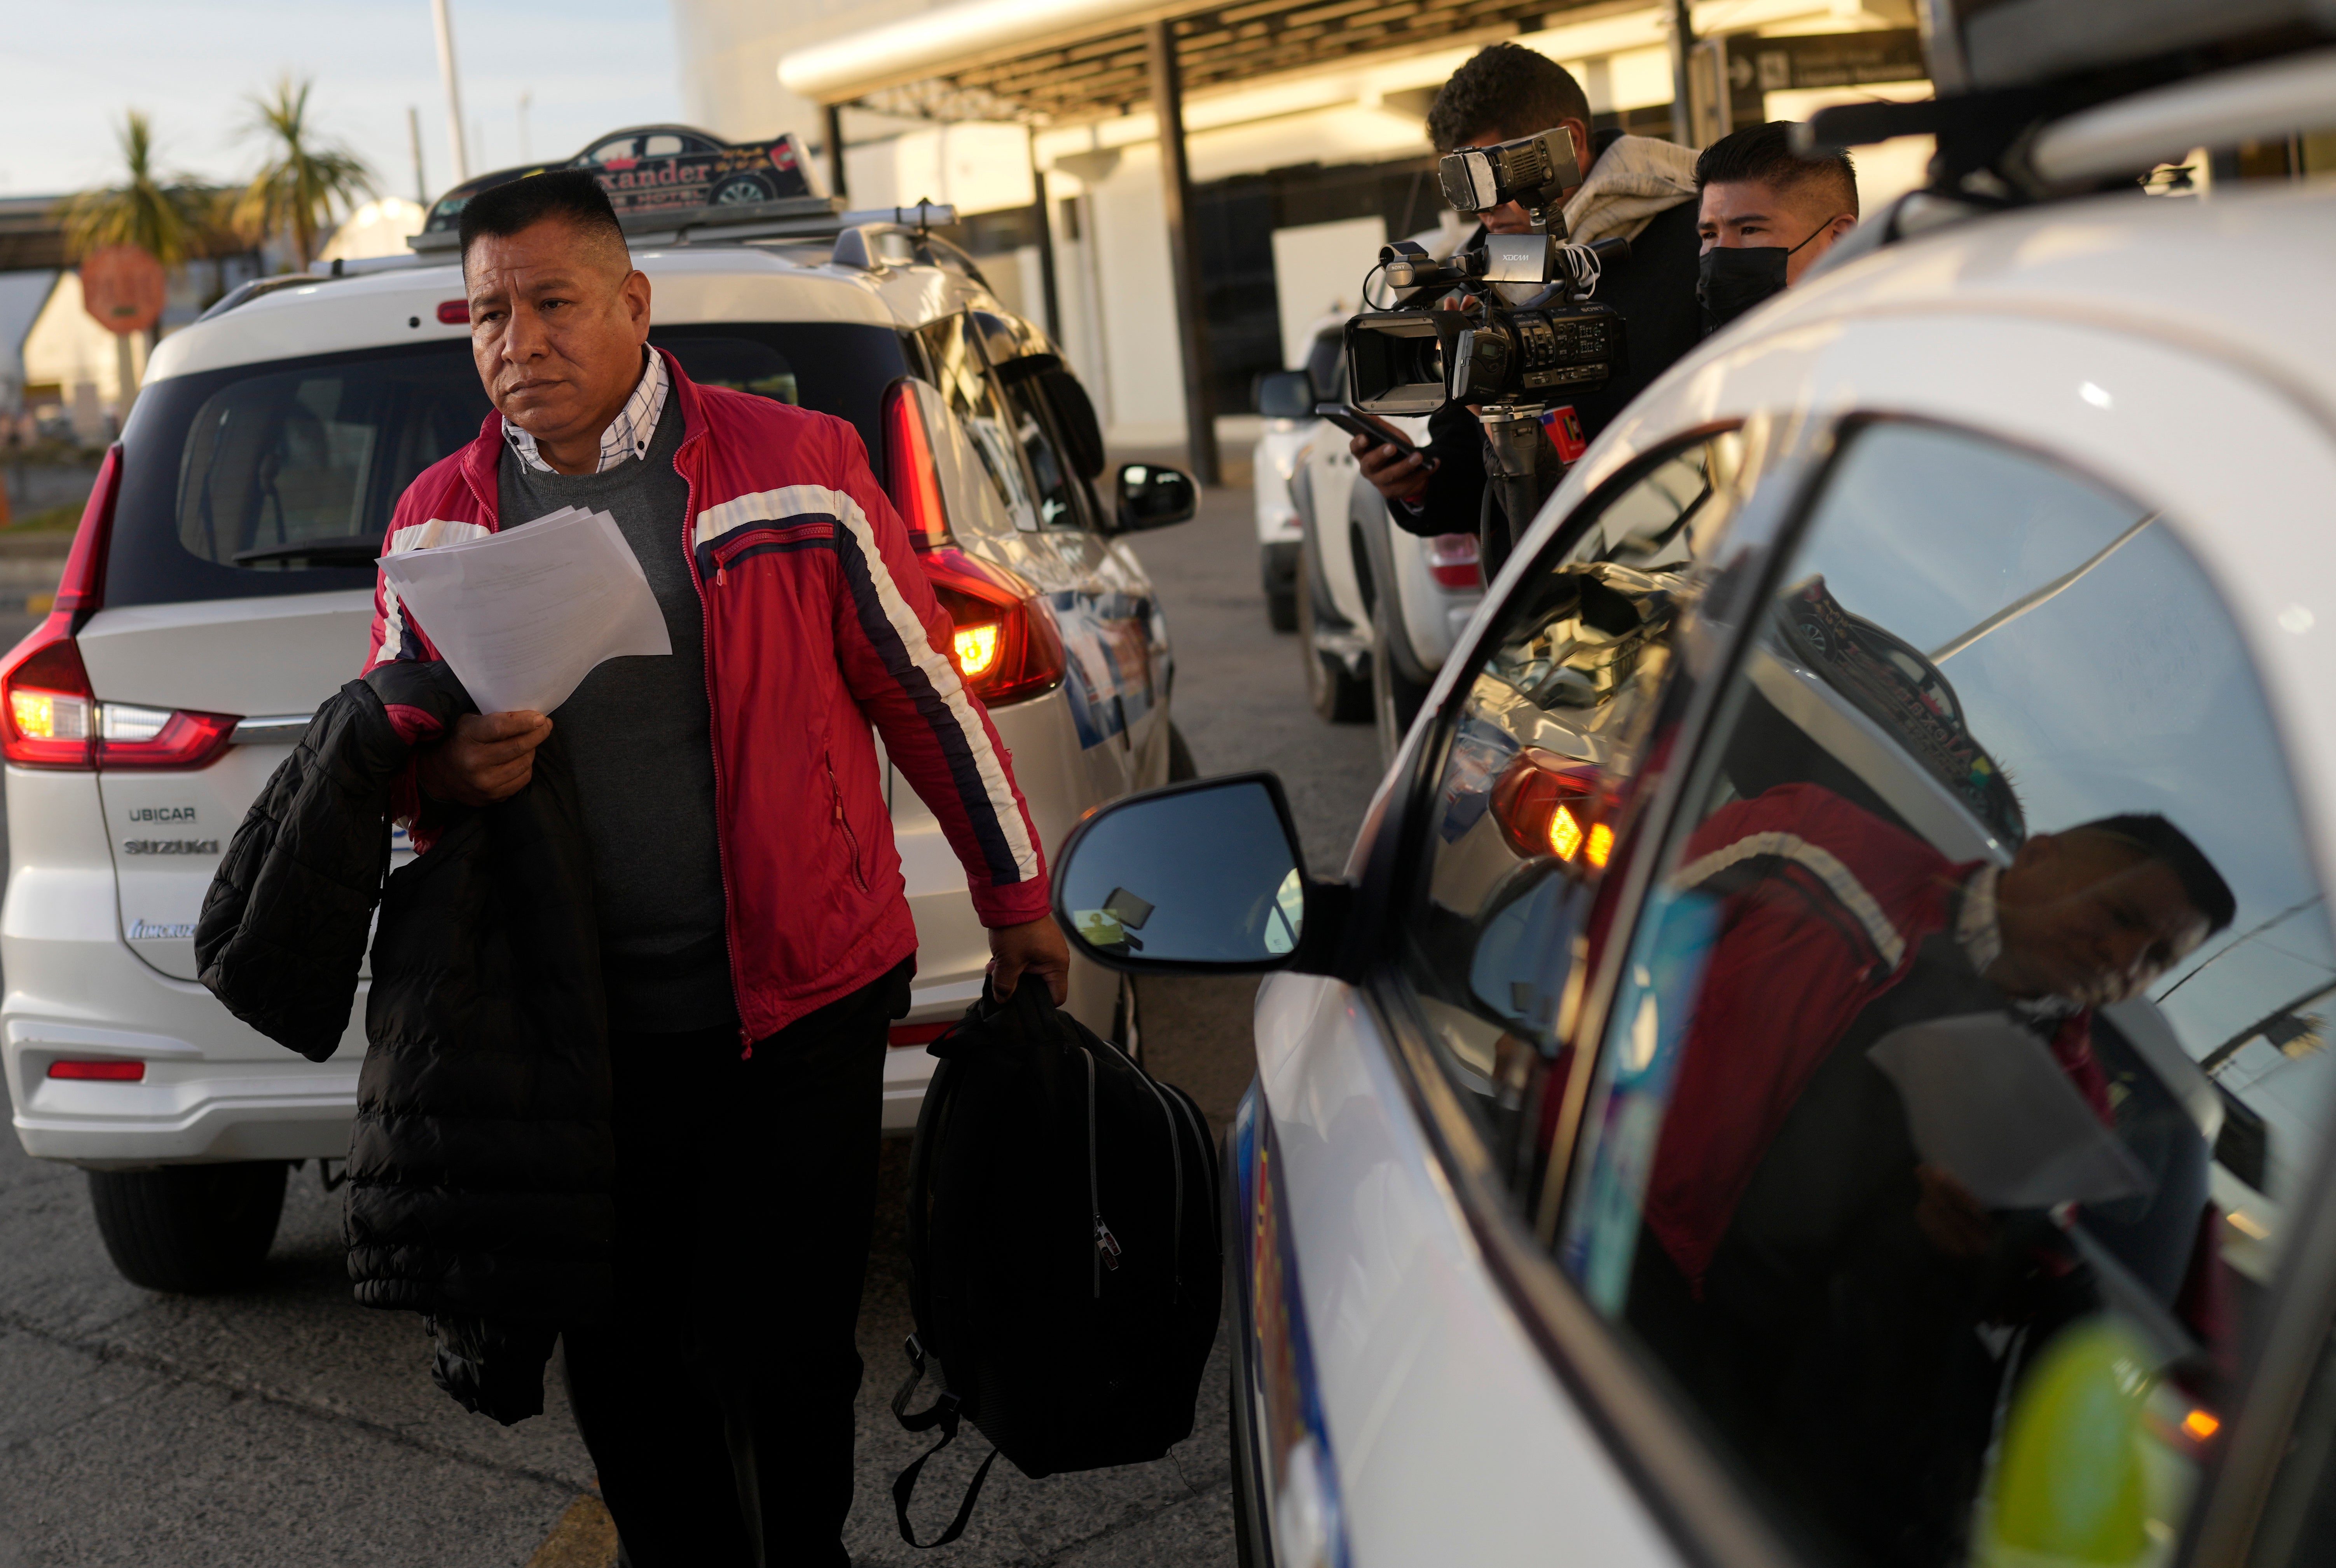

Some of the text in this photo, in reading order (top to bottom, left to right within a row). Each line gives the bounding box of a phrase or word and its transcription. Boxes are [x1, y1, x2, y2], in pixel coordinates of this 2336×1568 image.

[600, 159, 712, 190] xander
[129, 807, 196, 821] UBICAR
[123, 838, 219, 855] SUZUKI
